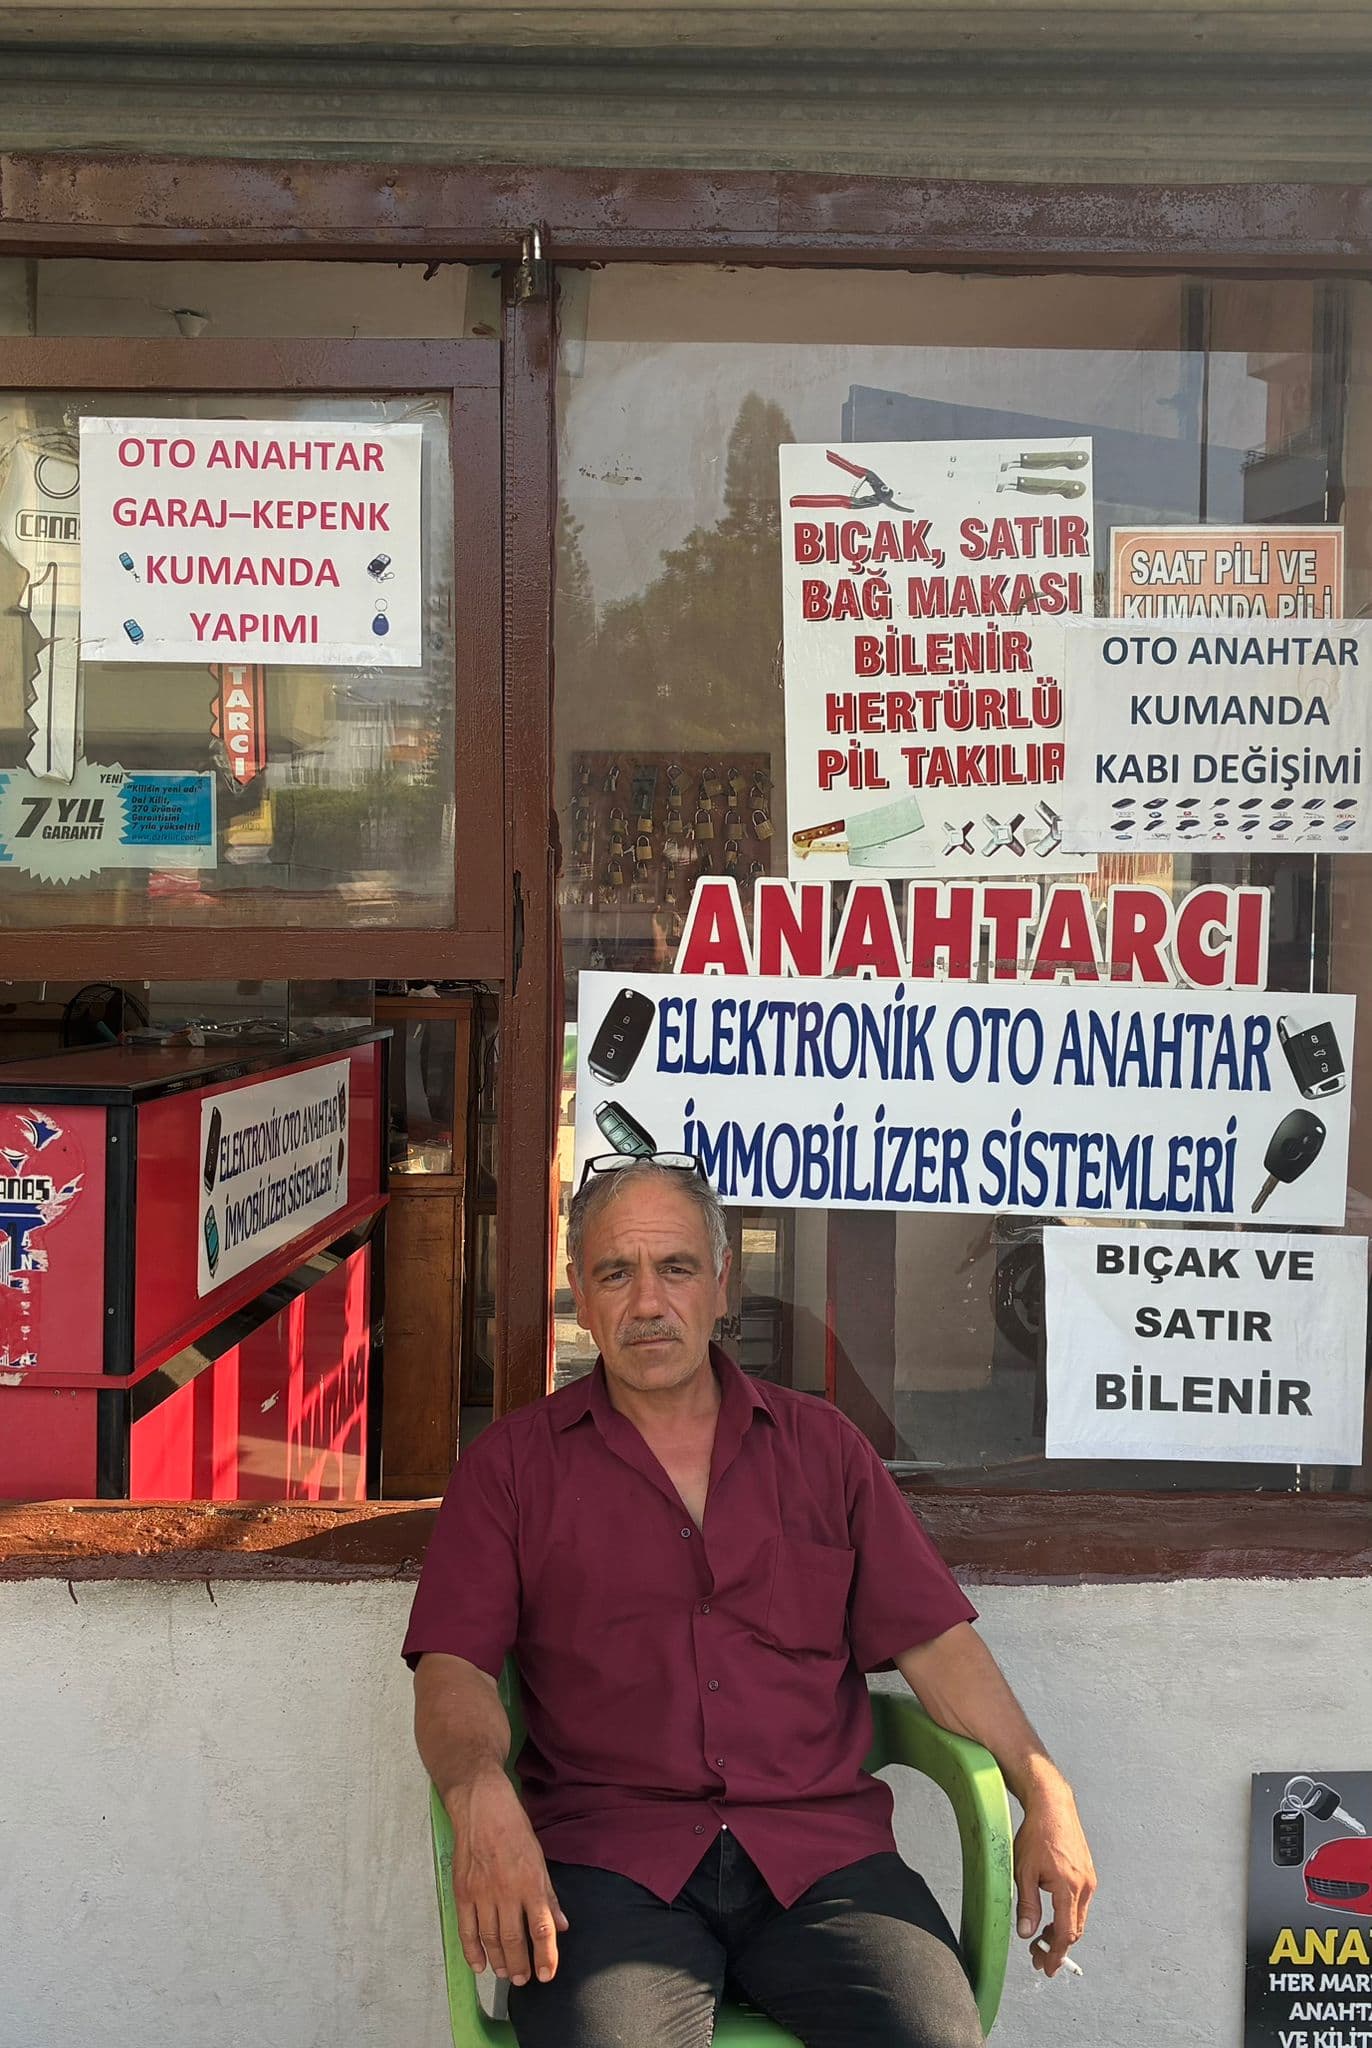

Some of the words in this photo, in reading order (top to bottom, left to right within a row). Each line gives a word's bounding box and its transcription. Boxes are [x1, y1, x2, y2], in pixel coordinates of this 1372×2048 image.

[117, 438, 195, 468] OTO
[206, 440, 385, 472] ANAHTAR
[20, 513, 80, 541] CANA
[793, 519, 946, 574] BIÇAK,
[959, 514, 1090, 560] SATIR
[146, 555, 340, 587] KUMANDA
[1131, 550, 1206, 585] SAAT
[1215, 541, 1270, 585] PİLİ
[1277, 549, 1317, 585] VE
[801, 568, 892, 622] BAĞ
[907, 570, 1082, 618] MAKASI
[1123, 594, 1270, 619] KUMANDA
[1277, 585, 1333, 619] PİLİ
[190, 612, 319, 644] YAPIMI
[853, 621, 1033, 677] BİLENİR
[1102, 636, 1178, 665] OTO
[1187, 637, 1360, 666] ANAHTAR
[825, 676, 1062, 735] HERTÜRLÜ
[1130, 695, 1331, 727] KUMANDA
[817, 738, 889, 791] PİL
[901, 741, 1064, 788] TAKILIR
[1095, 752, 1179, 785] KABI
[1193, 746, 1362, 791] DEĞİŞİMİ
[15, 797, 52, 838] 7
[57, 798, 105, 823] YIL
[131, 805, 149, 813] 270
[42, 823, 103, 840] GARANTİ
[680, 882, 1265, 989] ANAHTARCI
[656, 982, 937, 1082] ELEKTRONİK
[946, 1014, 1044, 1086] OTO
[1058, 1010, 1272, 1091] ANAHTAR
[219, 1106, 281, 1182] ELEKTRONİK
[283, 1109, 301, 1154] OTO
[302, 1095, 338, 1147] ANAHTAR
[682, 1098, 969, 1205] İMMOBİLİZER
[979, 1108, 1239, 1214] SİSTEMLERİ
[225, 1172, 287, 1251] İMMOBİLİZER
[288, 1144, 333, 1214] SİSTEMLERİ
[1095, 1244, 1240, 1285] BIÇAK
[1255, 1249, 1316, 1282] VE
[1134, 1307, 1273, 1343] SATIR
[1095, 1365, 1314, 1417] BİLENİR
[1268, 1928, 1372, 1966] ANA
[1269, 1972, 1317, 1993] HER
[1319, 1972, 1372, 1993] MAR
[1288, 2002, 1372, 2022] ANAHT
[1278, 2030, 1309, 2048] VE
